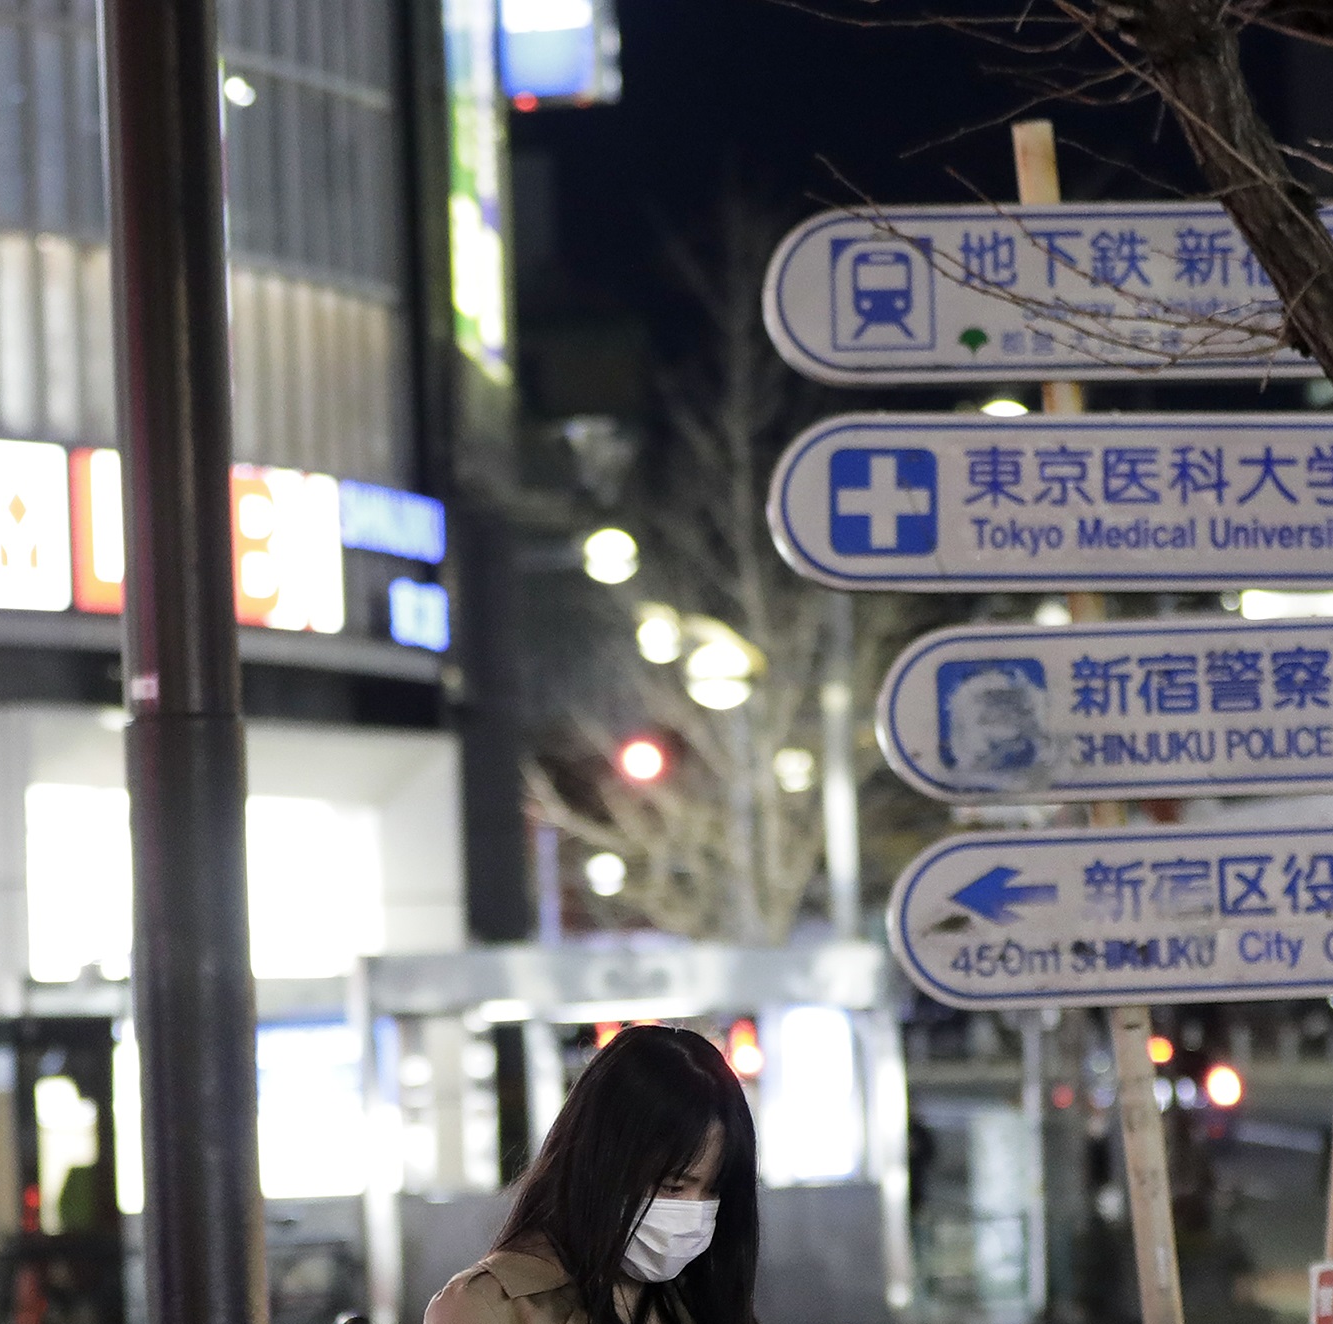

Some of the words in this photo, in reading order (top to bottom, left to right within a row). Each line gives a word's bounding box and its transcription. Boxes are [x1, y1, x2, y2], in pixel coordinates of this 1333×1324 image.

[959, 228, 1152, 288] 地下鉄
[970, 516, 1064, 557] Tokyo
[1077, 516, 1196, 549] Medical
[1237, 928, 1305, 969] City
